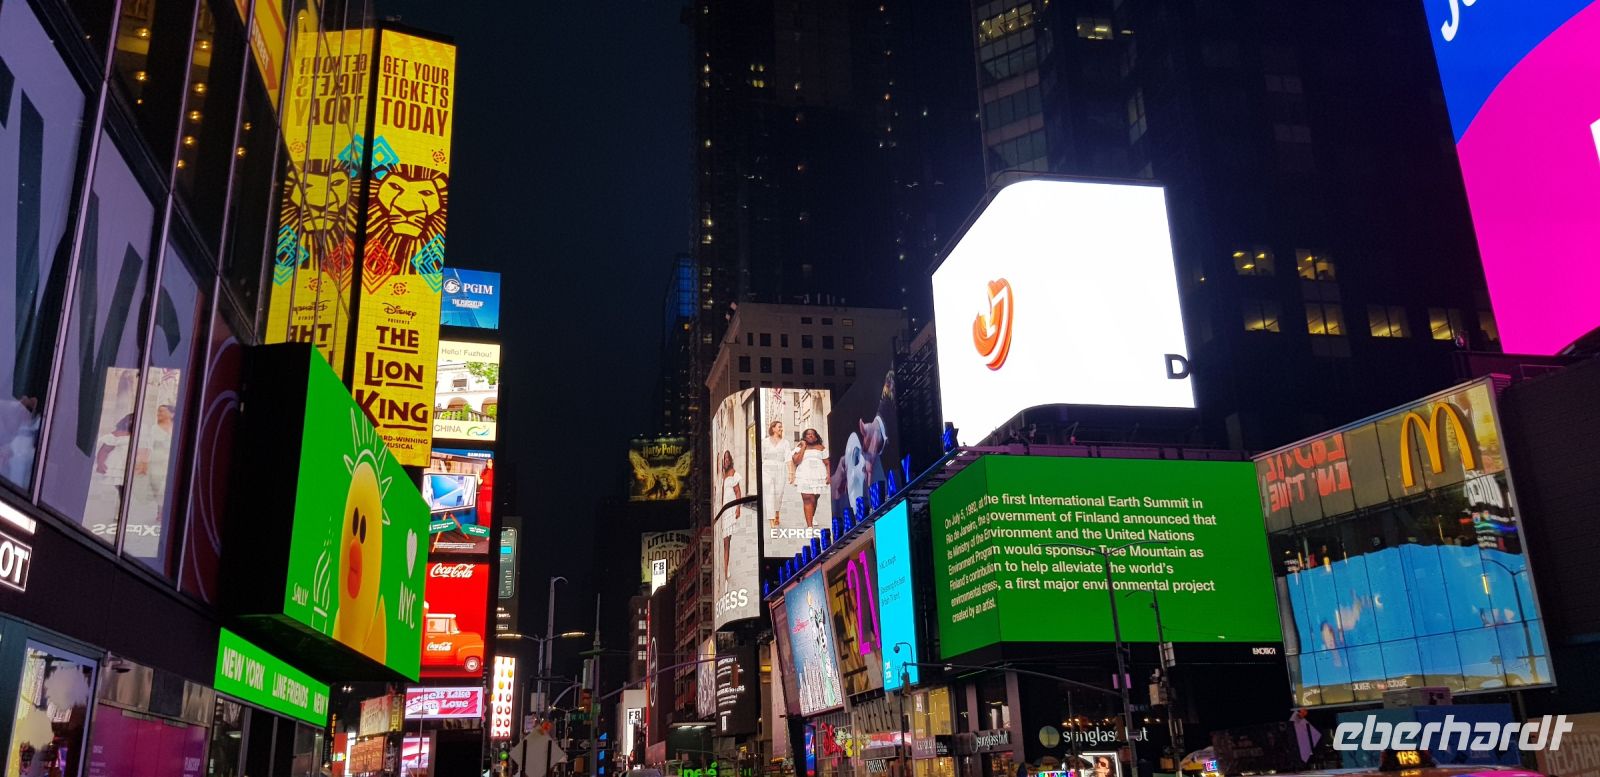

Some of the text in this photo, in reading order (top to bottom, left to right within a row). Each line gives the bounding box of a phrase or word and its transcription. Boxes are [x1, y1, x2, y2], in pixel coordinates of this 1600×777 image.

[384, 56, 448, 87] GET YOUR
[383, 74, 449, 109] TICKETS
[381, 97, 449, 138] TODAY
[463, 283, 493, 295] PGIM
[382, 302, 417, 320] Disney
[376, 326, 420, 348] THE
[364, 352, 424, 387] LION
[356, 389, 429, 428] KING
[434, 424, 462, 433] CHINA
[984, 494, 999, 506] the
[1002, 493, 1026, 506] first
[1030, 494, 1106, 507] International
[1108, 496, 1140, 508] Earth
[1144, 496, 1190, 508] Summit
[1192, 498, 1203, 509] in
[986, 512, 1057, 525] government
[1060, 512, 1072, 522] of
[1075, 512, 1120, 524] Finland
[1123, 514, 1190, 525] announced
[1193, 514, 1217, 526] that
[648, 533, 674, 550] LITTLE
[770, 528, 822, 540] EXPRES
[984, 527, 1053, 540] Environment
[1056, 528, 1078, 540] and
[1082, 528, 1102, 540] the
[1106, 528, 1146, 540] United
[1148, 530, 1195, 542] Nations
[1004, 544, 1042, 556] would
[1046, 546, 1096, 558] sponsor
[1099, 545, 1126, 557] Tree
[1130, 546, 1187, 558] Mountain
[1190, 548, 1204, 558] as
[430, 563, 475, 578] Coca-Cola
[1006, 561, 1018, 572] to
[1022, 561, 1049, 574] help
[1052, 561, 1103, 574] alleviate
[1004, 581, 1014, 590] a
[1016, 578, 1041, 590] first
[1044, 580, 1080, 592] major
[1082, 579, 1170, 592] envionmental
[1172, 580, 1216, 594] project
[292, 583, 310, 607] SALLY
[398, 582, 416, 630] NYC
[846, 551, 882, 658] 21
[222, 646, 245, 682] NEW
[245, 656, 266, 692] YORK
[272, 672, 288, 702] LINE
[287, 678, 310, 710] FRIENDS
